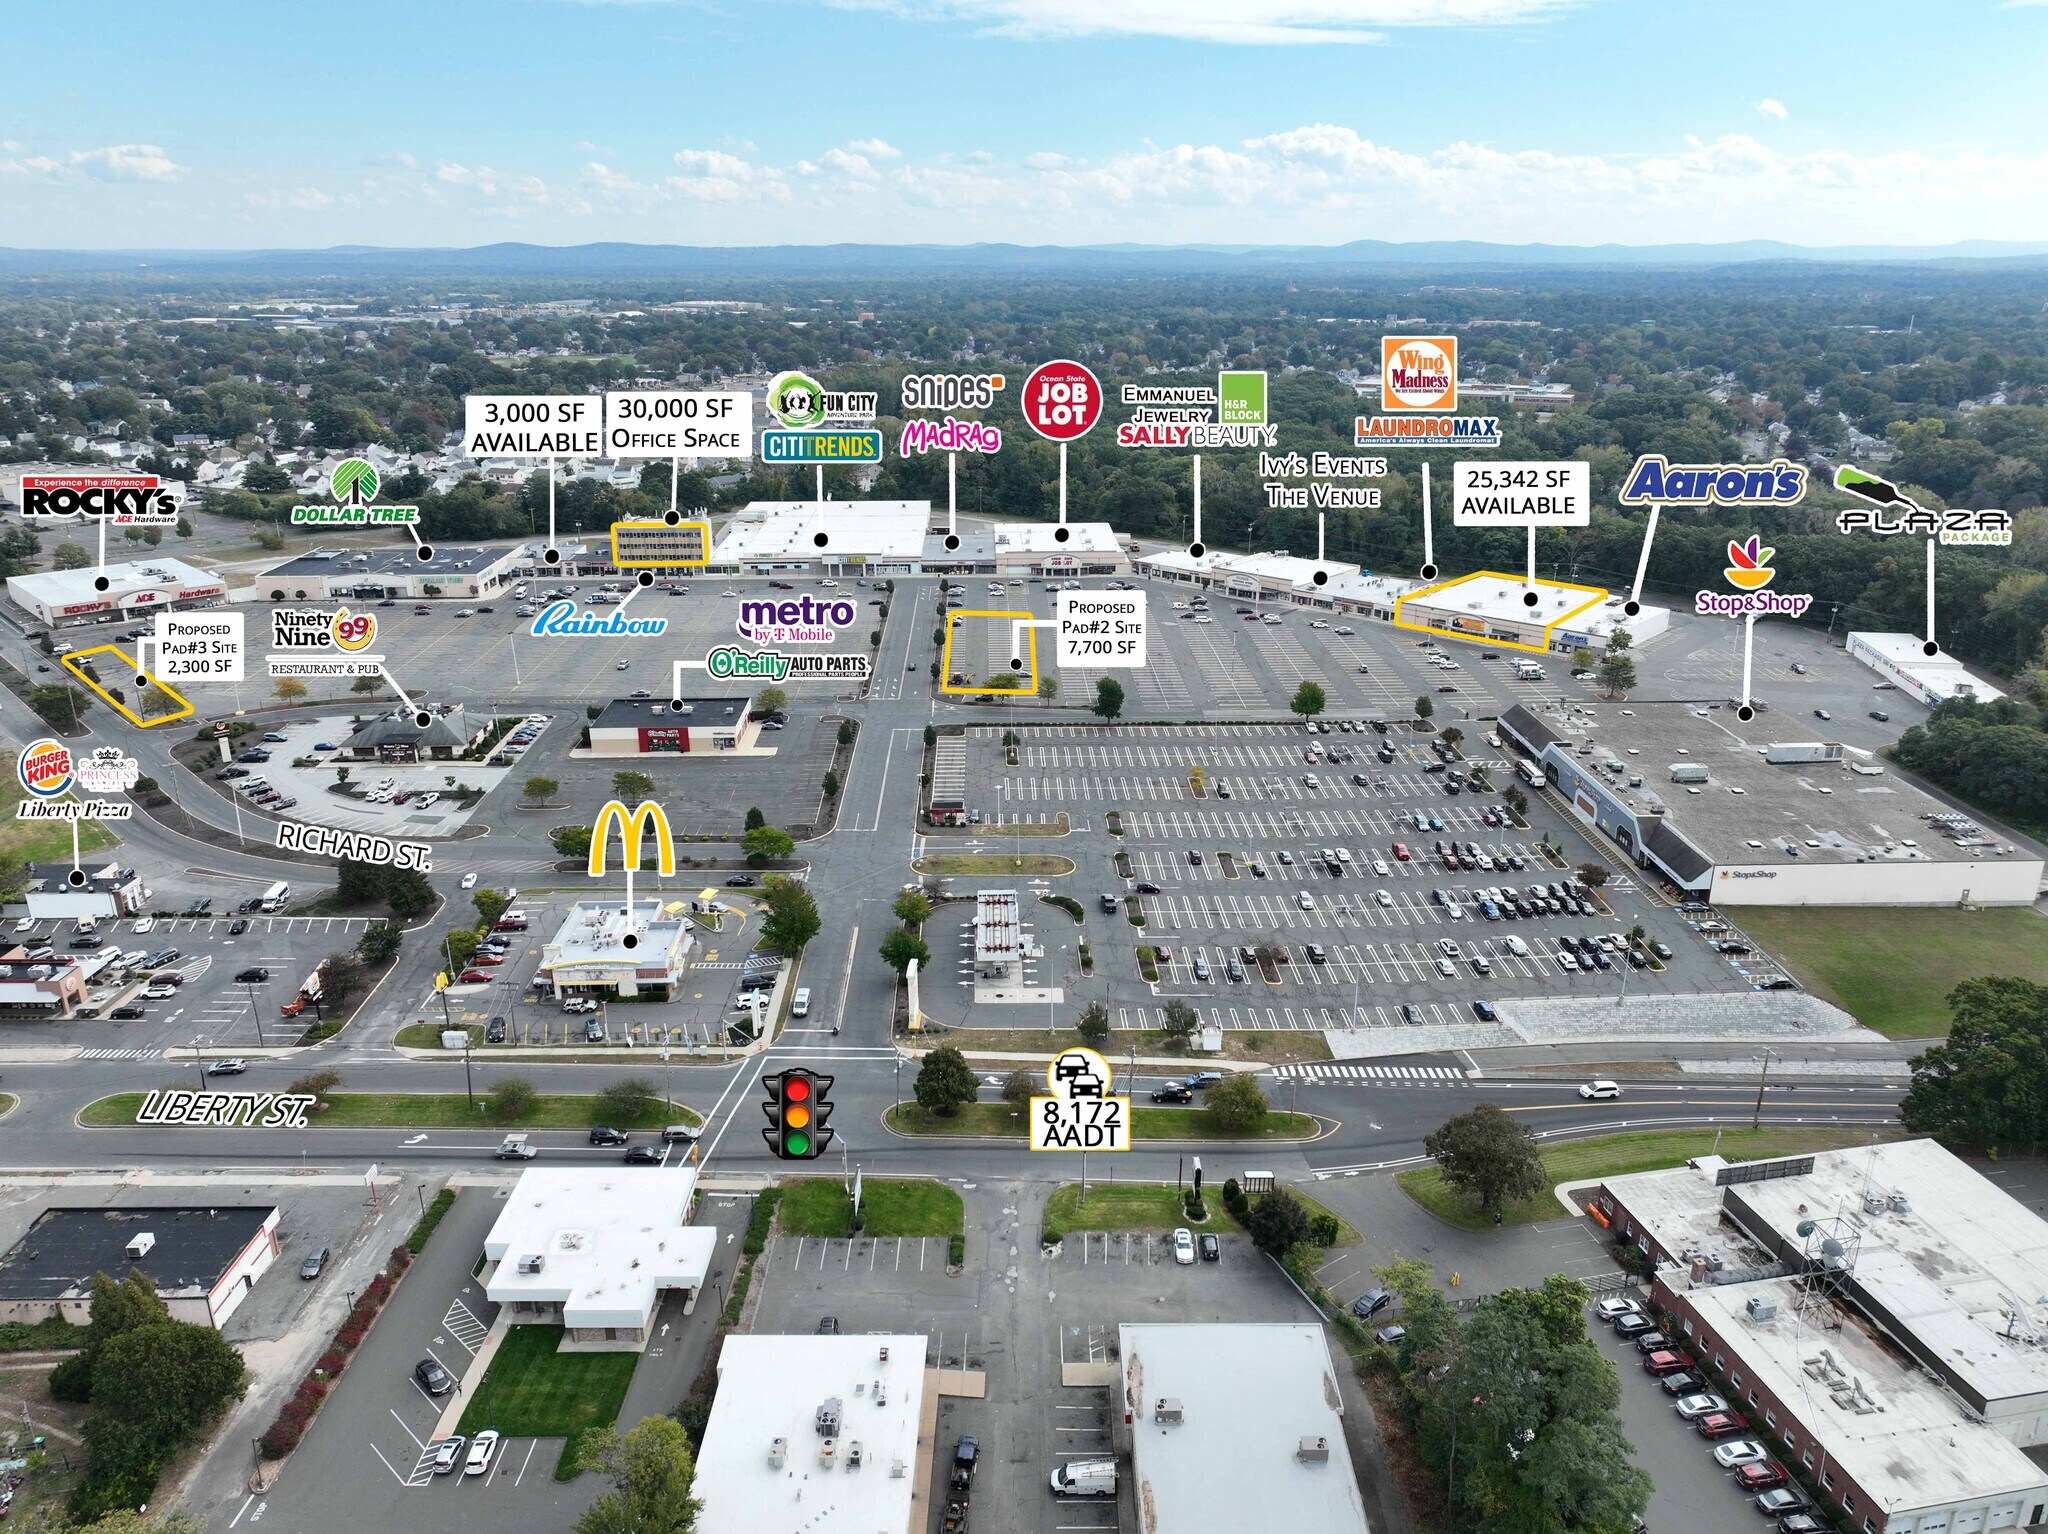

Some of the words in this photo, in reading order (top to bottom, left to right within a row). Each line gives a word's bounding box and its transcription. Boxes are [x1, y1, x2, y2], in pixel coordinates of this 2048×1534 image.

[135, 592, 155, 603] ACE
[1732, 870, 1777, 879] Stop&Shop
[250, 1502, 268, 1521] STOP
